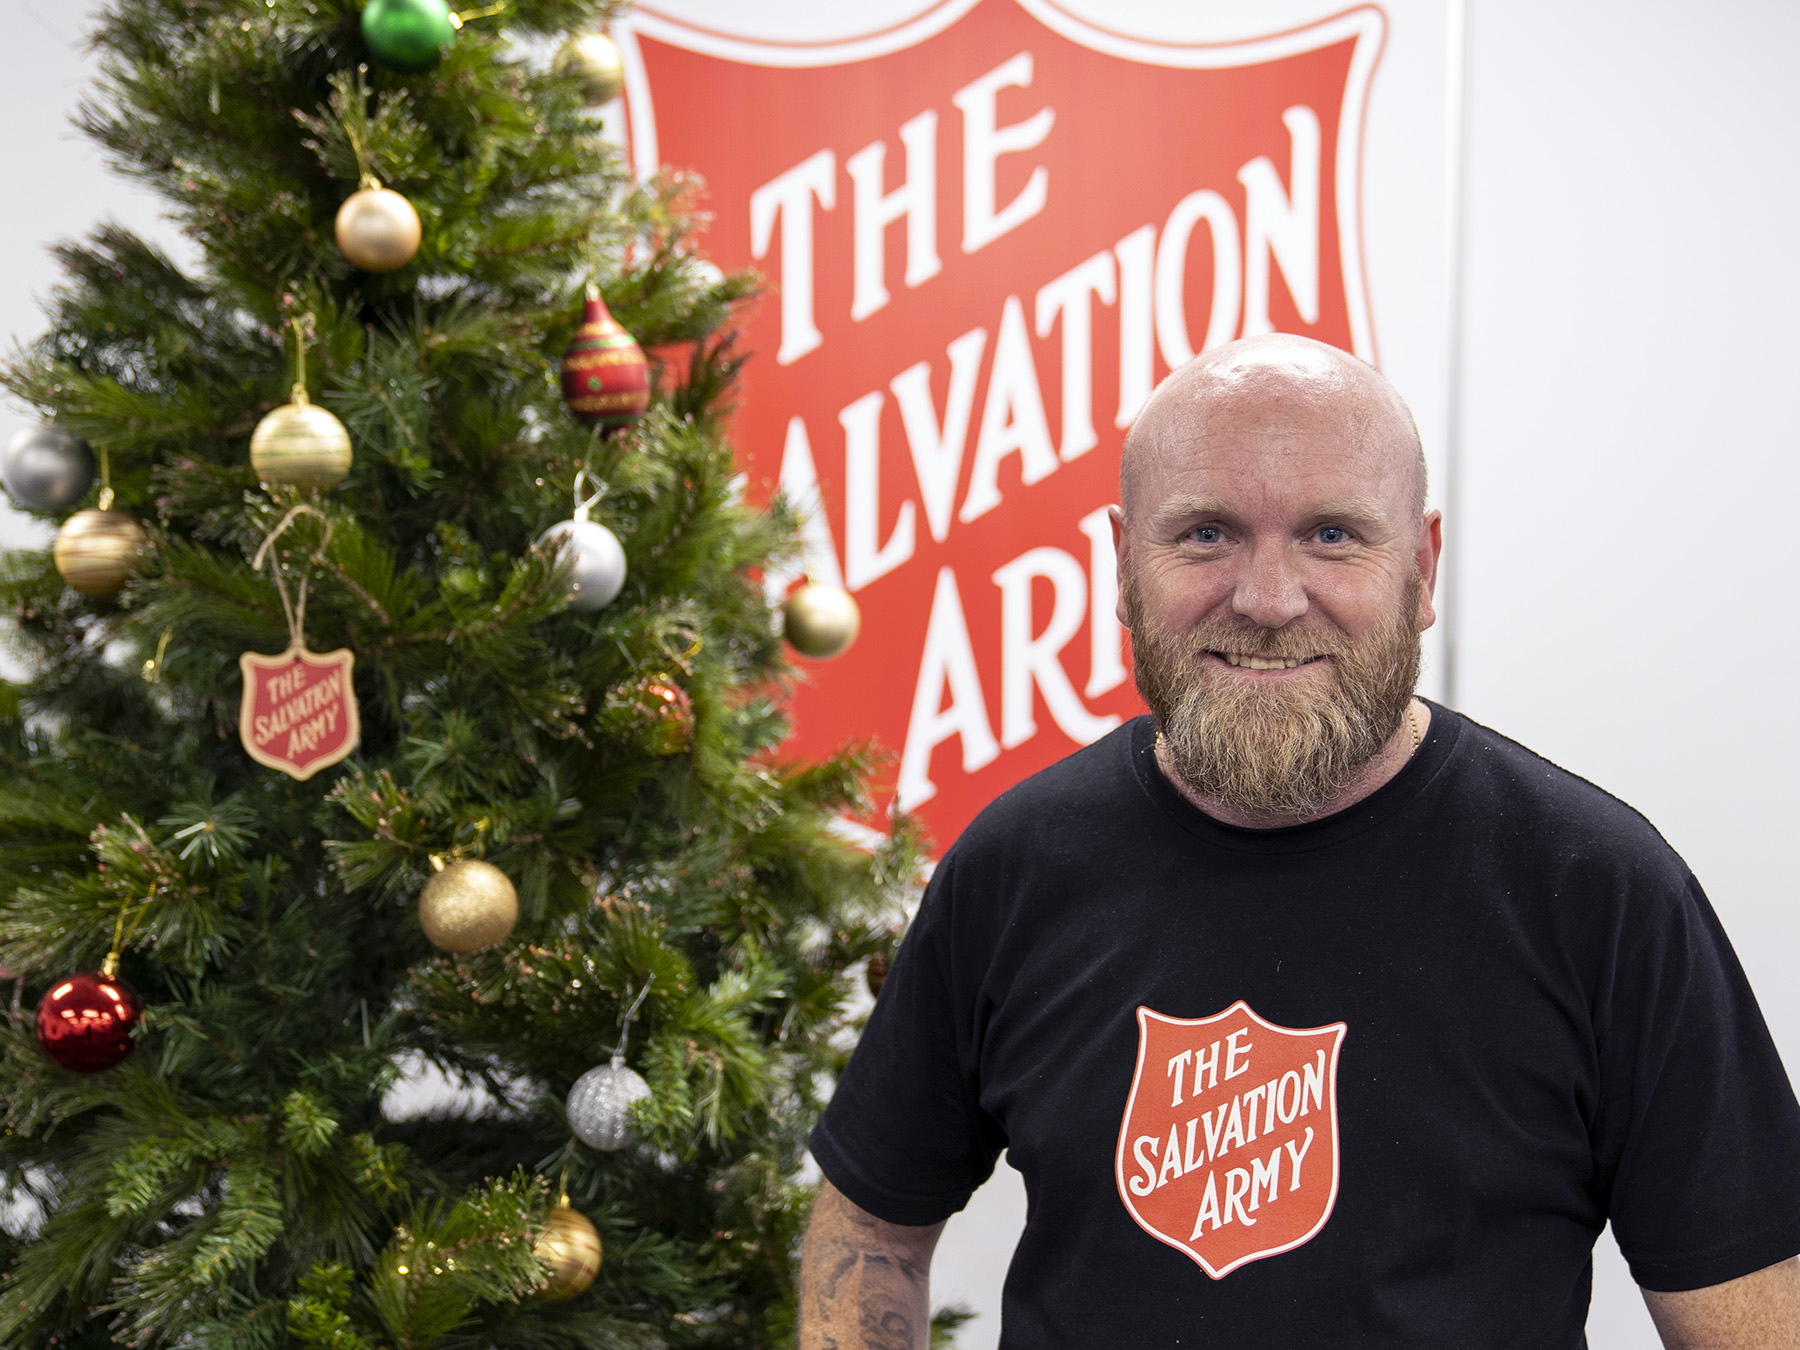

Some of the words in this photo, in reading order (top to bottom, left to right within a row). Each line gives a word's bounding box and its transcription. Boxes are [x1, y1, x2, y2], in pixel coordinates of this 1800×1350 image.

[750, 51, 1056, 367] THE
[724, 104, 1321, 636] ALVATION
[255, 668, 341, 746] SALVATION
[266, 664, 306, 704] THE
[895, 503, 1128, 818] AR
[287, 702, 339, 760] ARMY
[1129, 1049, 1326, 1197] SALVATION
[1167, 1026, 1253, 1107] THE
[1189, 1126, 1314, 1242] ARMY
